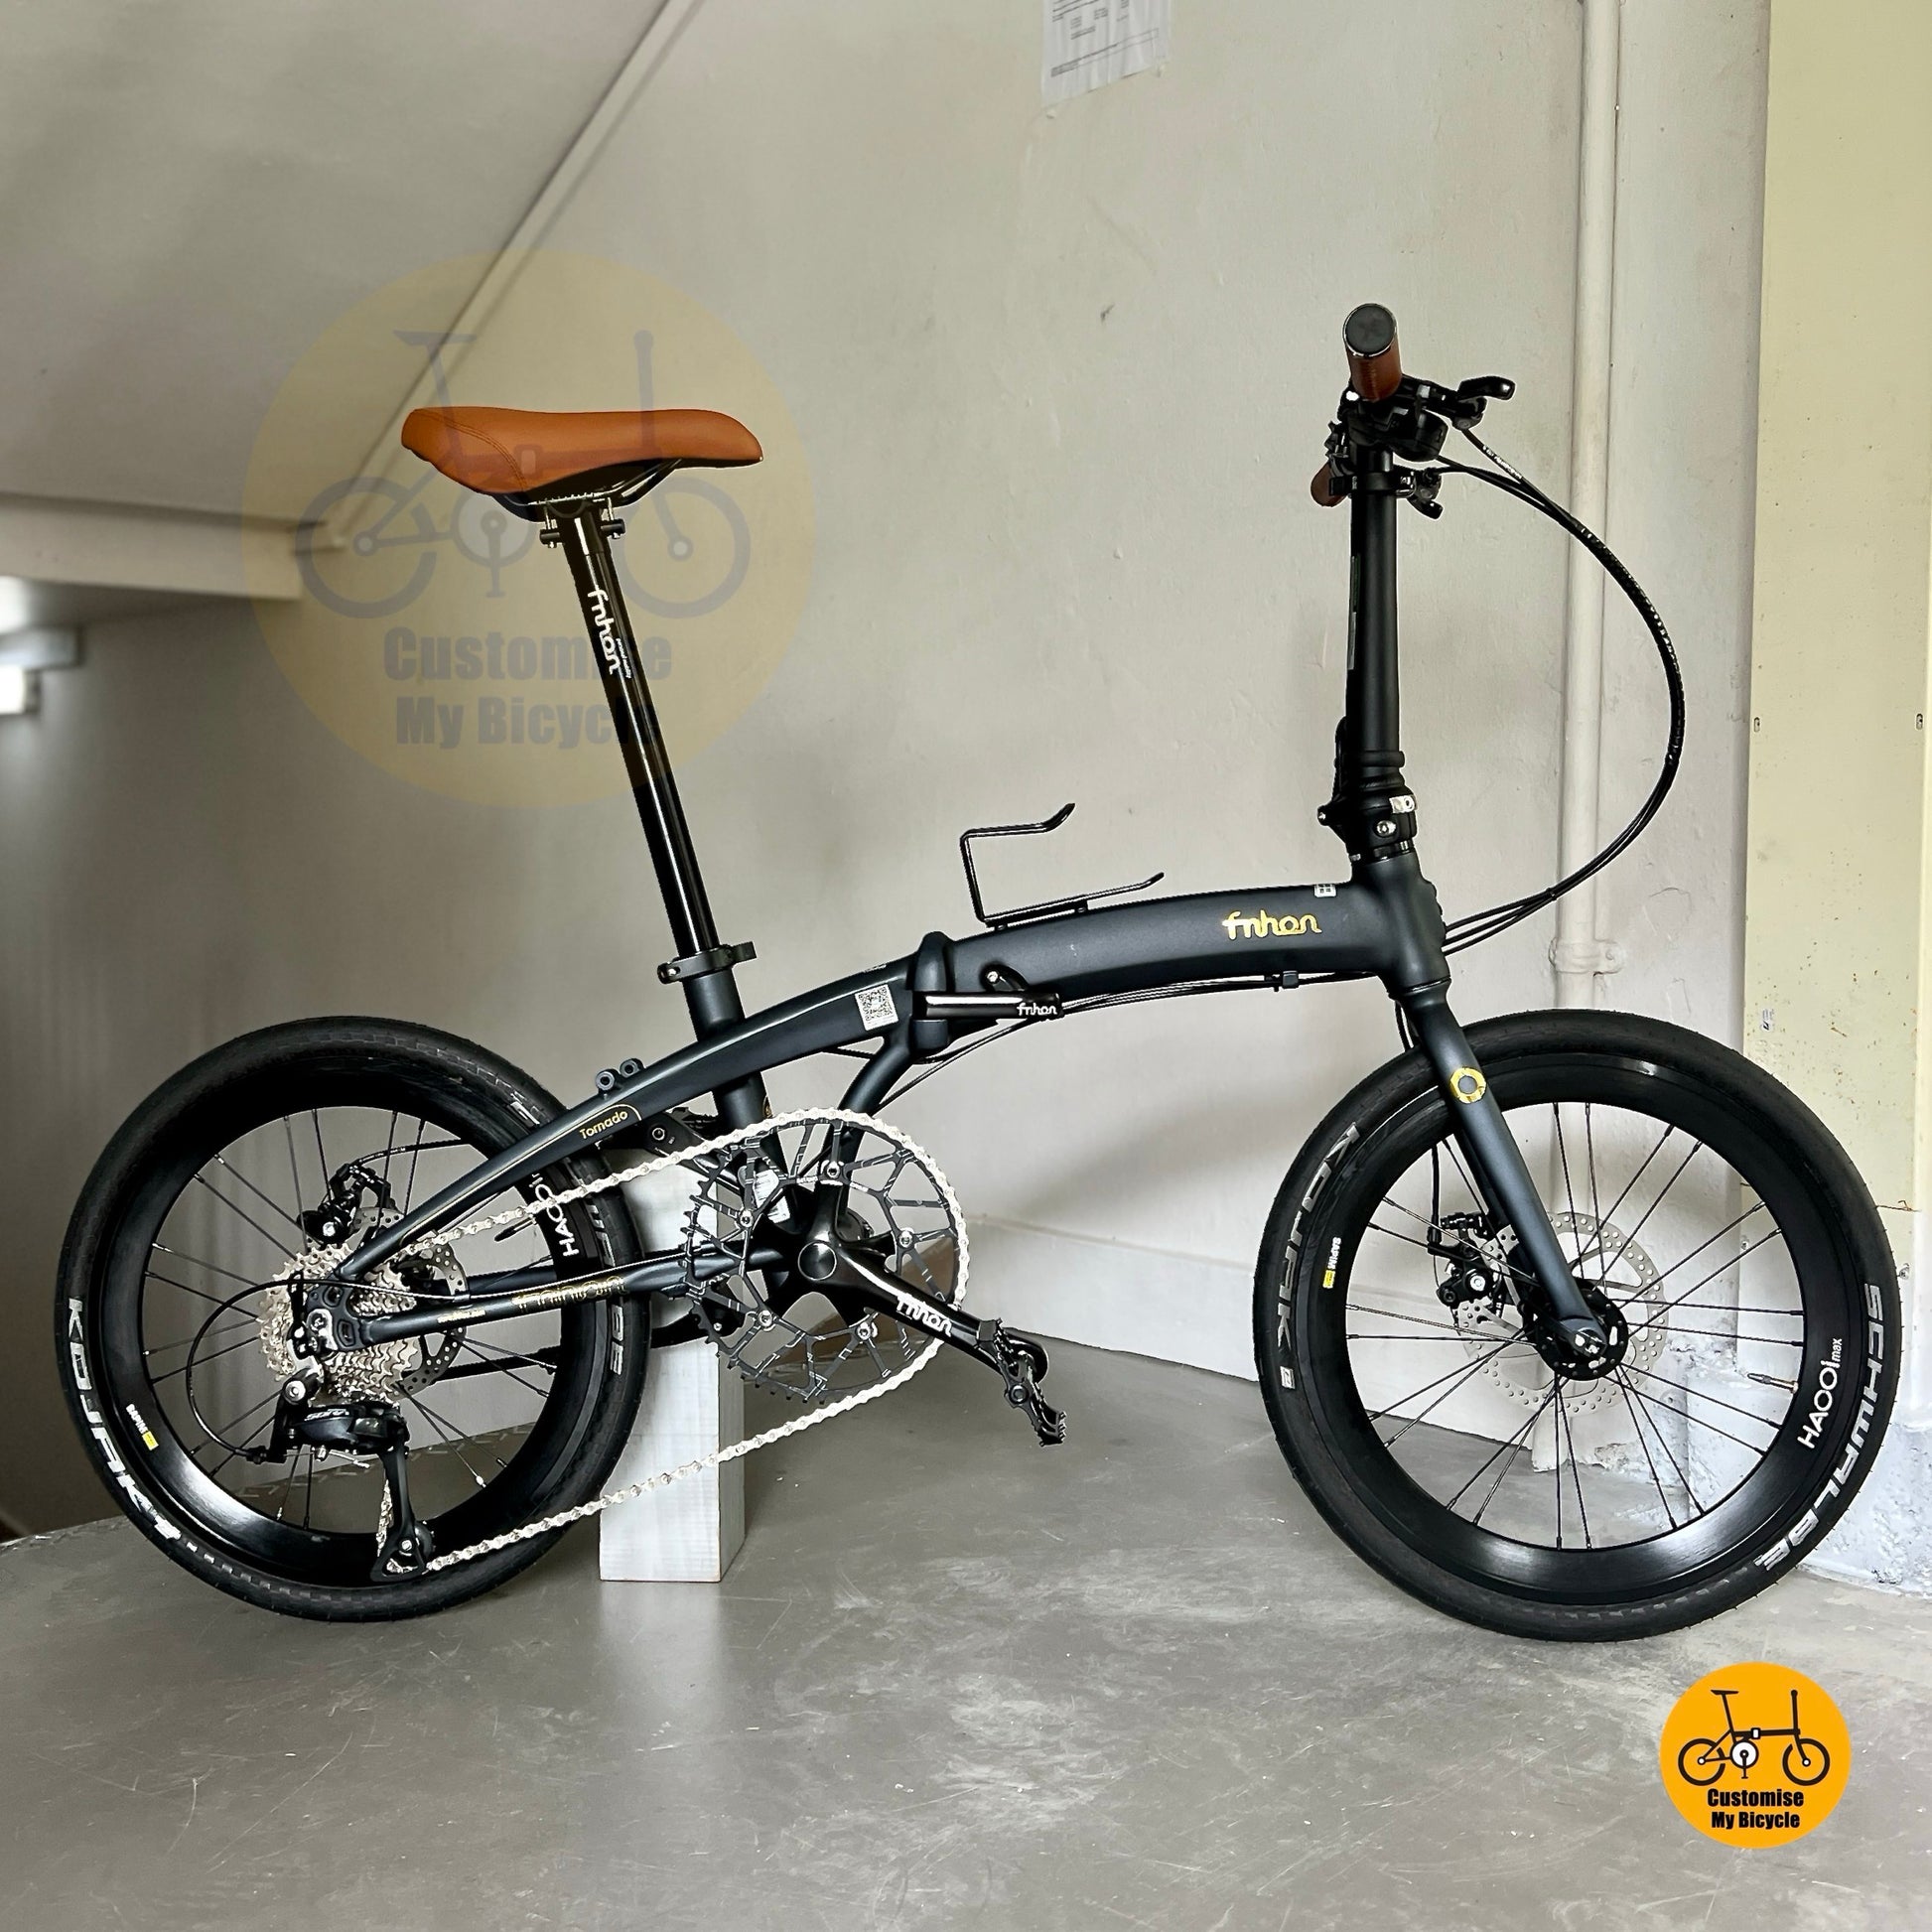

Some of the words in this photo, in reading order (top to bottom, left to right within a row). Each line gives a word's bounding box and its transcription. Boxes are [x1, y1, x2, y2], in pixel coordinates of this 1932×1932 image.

[1221, 909, 1322, 941] fnhon
[579, 1111, 628, 1140] Tornado
[1278, 1123, 1360, 1351] KOJAK
[69, 1298, 157, 1517] KOJAK
[1754, 1283, 1884, 1572] SCHWALBE
